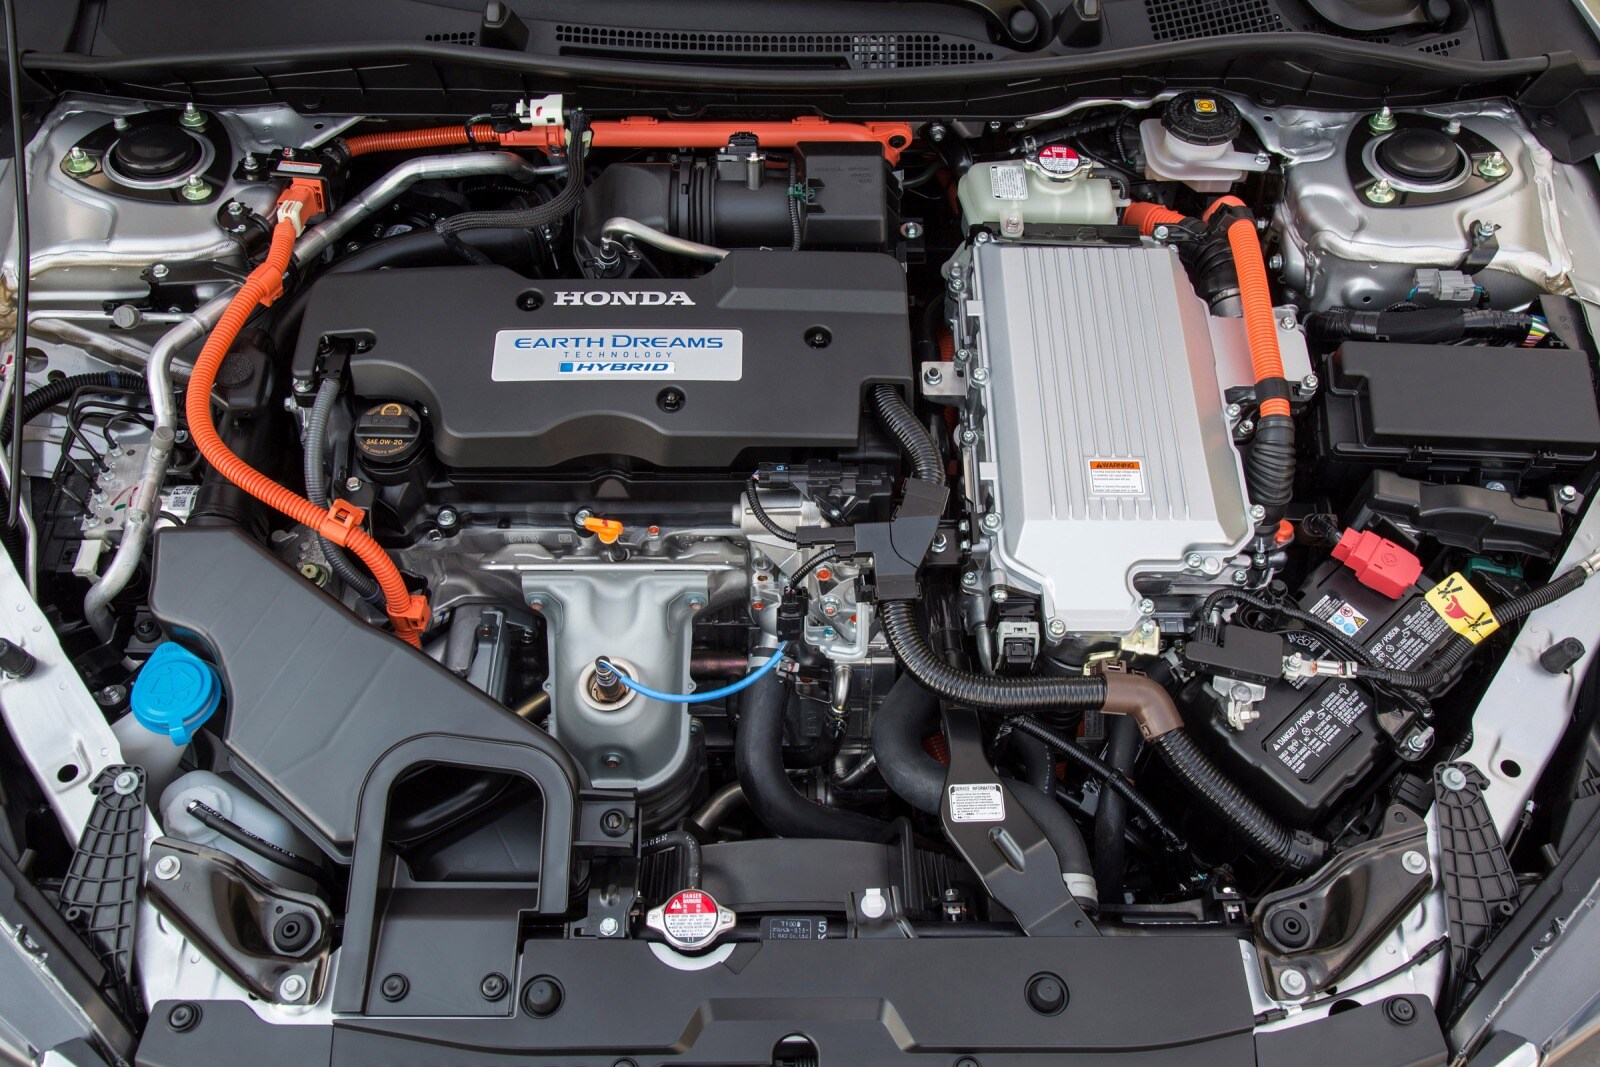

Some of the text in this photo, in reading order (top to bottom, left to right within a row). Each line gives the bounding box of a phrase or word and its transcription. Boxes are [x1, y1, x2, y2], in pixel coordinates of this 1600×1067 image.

[553, 291, 696, 306] HONDA
[514, 334, 723, 349] EARTH DREAMS
[576, 363, 669, 372] HYBRID
[1276, 725, 1297, 746] DANGER
[1295, 707, 1315, 727] POISON
[818, 921, 826, 932] 5
